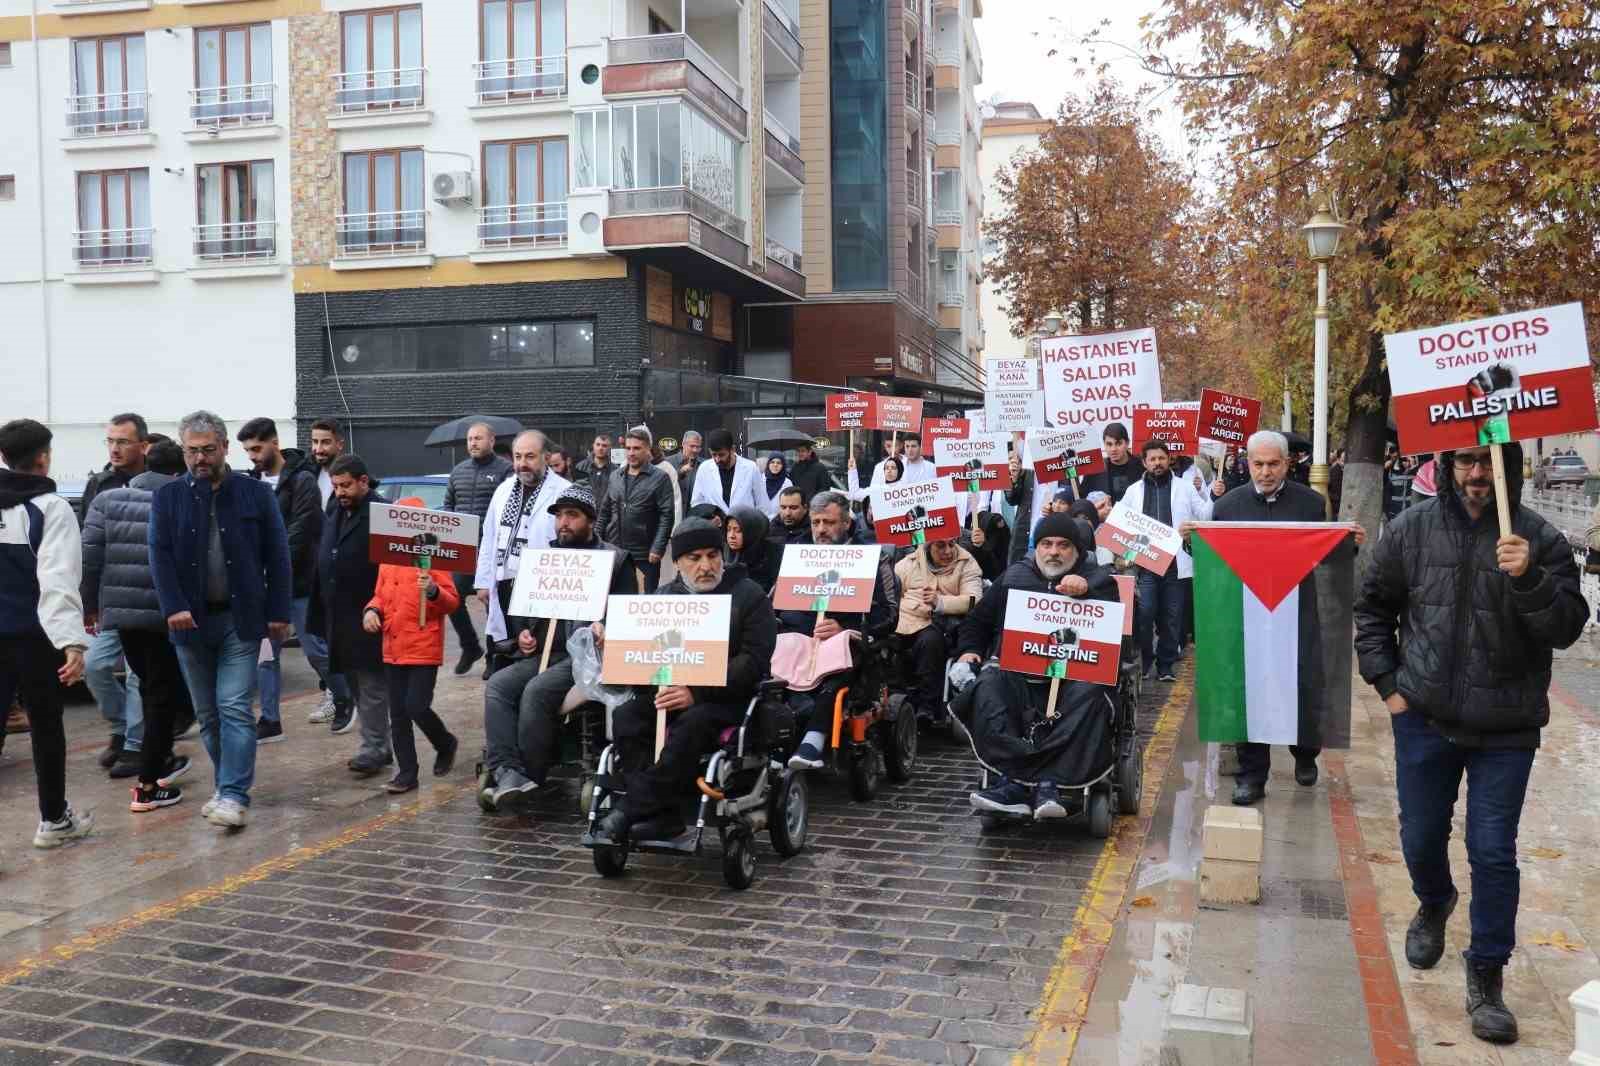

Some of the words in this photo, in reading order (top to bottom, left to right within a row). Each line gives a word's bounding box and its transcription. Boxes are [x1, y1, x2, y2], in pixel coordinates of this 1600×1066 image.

[1418, 317, 1550, 355] DOCTORS
[1045, 339, 1153, 363] HASTANEYE
[1435, 351, 1489, 369] STAND
[1494, 343, 1537, 360] WITH
[997, 360, 1026, 368] BEYAZ
[1063, 362, 1136, 383] SALDIRI
[1072, 384, 1131, 403] SAVAŞ
[834, 401, 868, 409] DOKTORUM
[1212, 402, 1248, 417] DOCTOR
[1429, 387, 1558, 422] PALESTINE
[1171, 411, 1178, 419] A
[1146, 419, 1185, 428] DOCTOR
[1216, 417, 1232, 427] NOT
[1234, 421, 1240, 429] A
[1040, 430, 1086, 447] DOCTORS
[1152, 432, 1170, 440] NOT
[1172, 432, 1179, 440] A
[1210, 426, 1244, 441] TARGET!
[946, 441, 996, 451] DOCTORS
[1046, 455, 1091, 472] PALESTINE
[951, 470, 997, 481] PALESTINE
[884, 482, 939, 501] DOCTORS
[892, 498, 915, 508] STAND
[916, 495, 935, 505] WITH
[388, 509, 461, 526] DOCTORS
[1124, 510, 1172, 538] DOCTORS
[396, 521, 427, 531] STAND
[429, 525, 453, 533] WITH
[890, 517, 945, 534] PALESTINE
[388, 542, 460, 559] PALESTINE
[1111, 532, 1160, 561] PALESTINE
[539, 553, 593, 568] BEYAZ
[799, 549, 864, 560] DOCTORS
[537, 576, 584, 591] KANA
[792, 584, 856, 596] PALESTINE
[628, 601, 710, 615] DOCTORS
[1027, 597, 1105, 618] DOCTORS
[636, 618, 671, 627] STAND
[673, 617, 700, 627] WITH
[1034, 613, 1067, 625] STAND
[1069, 618, 1095, 628] WITH
[624, 651, 705, 664] PALESTINE
[1022, 641, 1098, 663] PALESTINE
